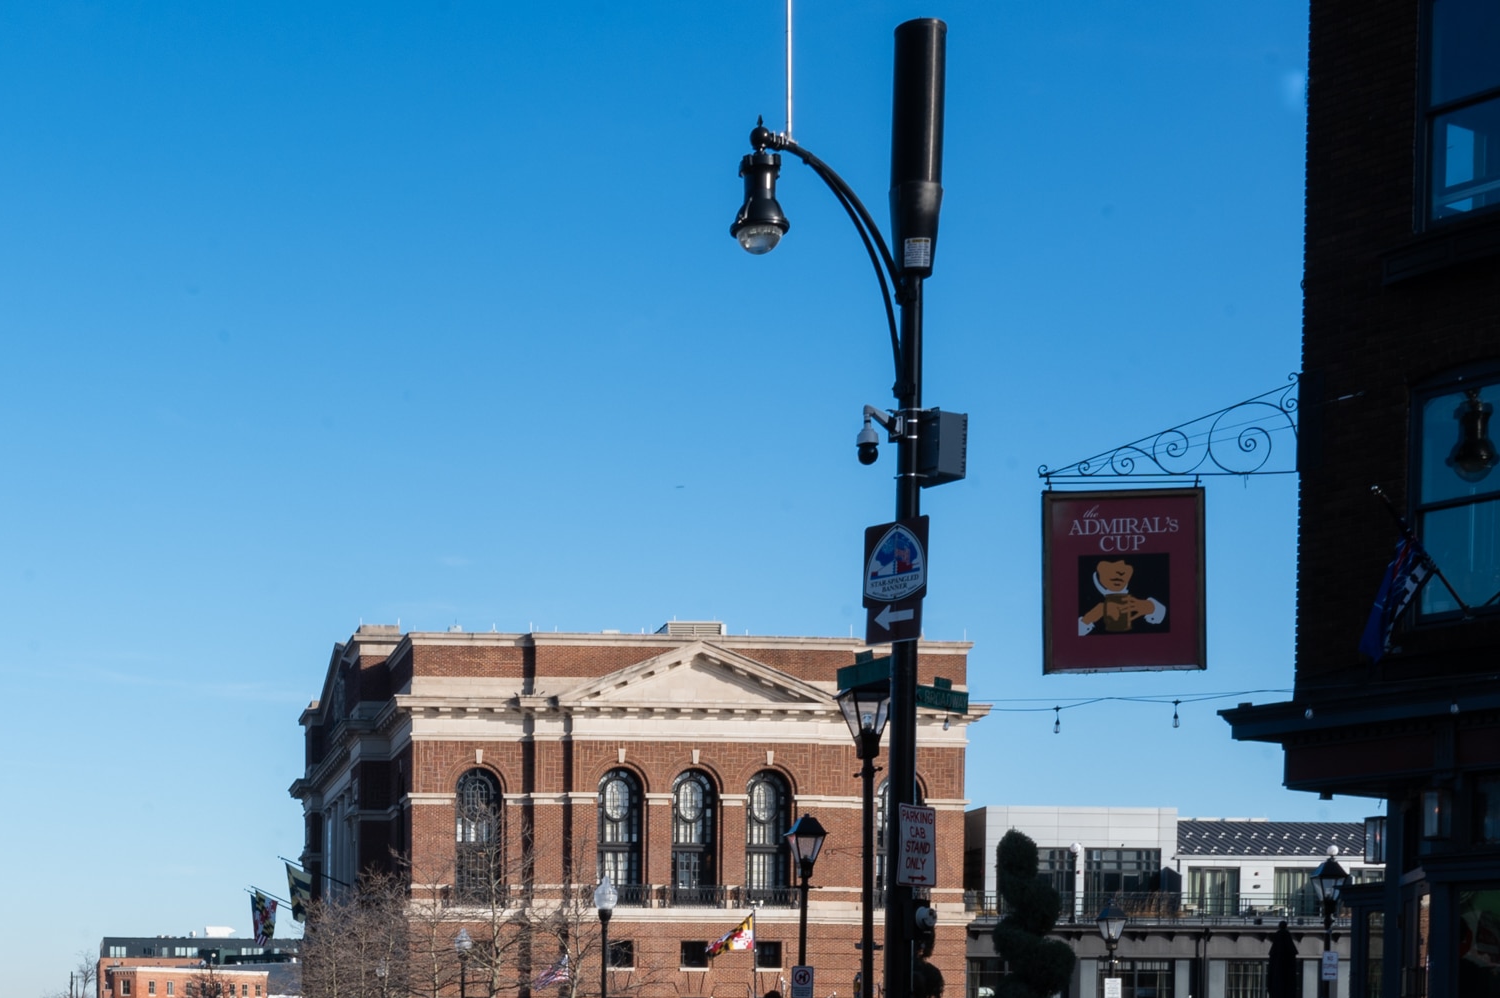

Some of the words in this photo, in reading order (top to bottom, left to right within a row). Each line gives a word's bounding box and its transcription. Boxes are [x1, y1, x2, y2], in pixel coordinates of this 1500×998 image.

[1083, 505, 1099, 518] the
[1099, 535, 1146, 552] CUP
[881, 582, 908, 593] BANNER
[924, 690, 968, 709] BROADWAY
[901, 809, 933, 825] PARKING
[910, 826, 926, 839] CAB
[905, 841, 930, 855] STAND
[905, 857, 926, 871] ONLY
